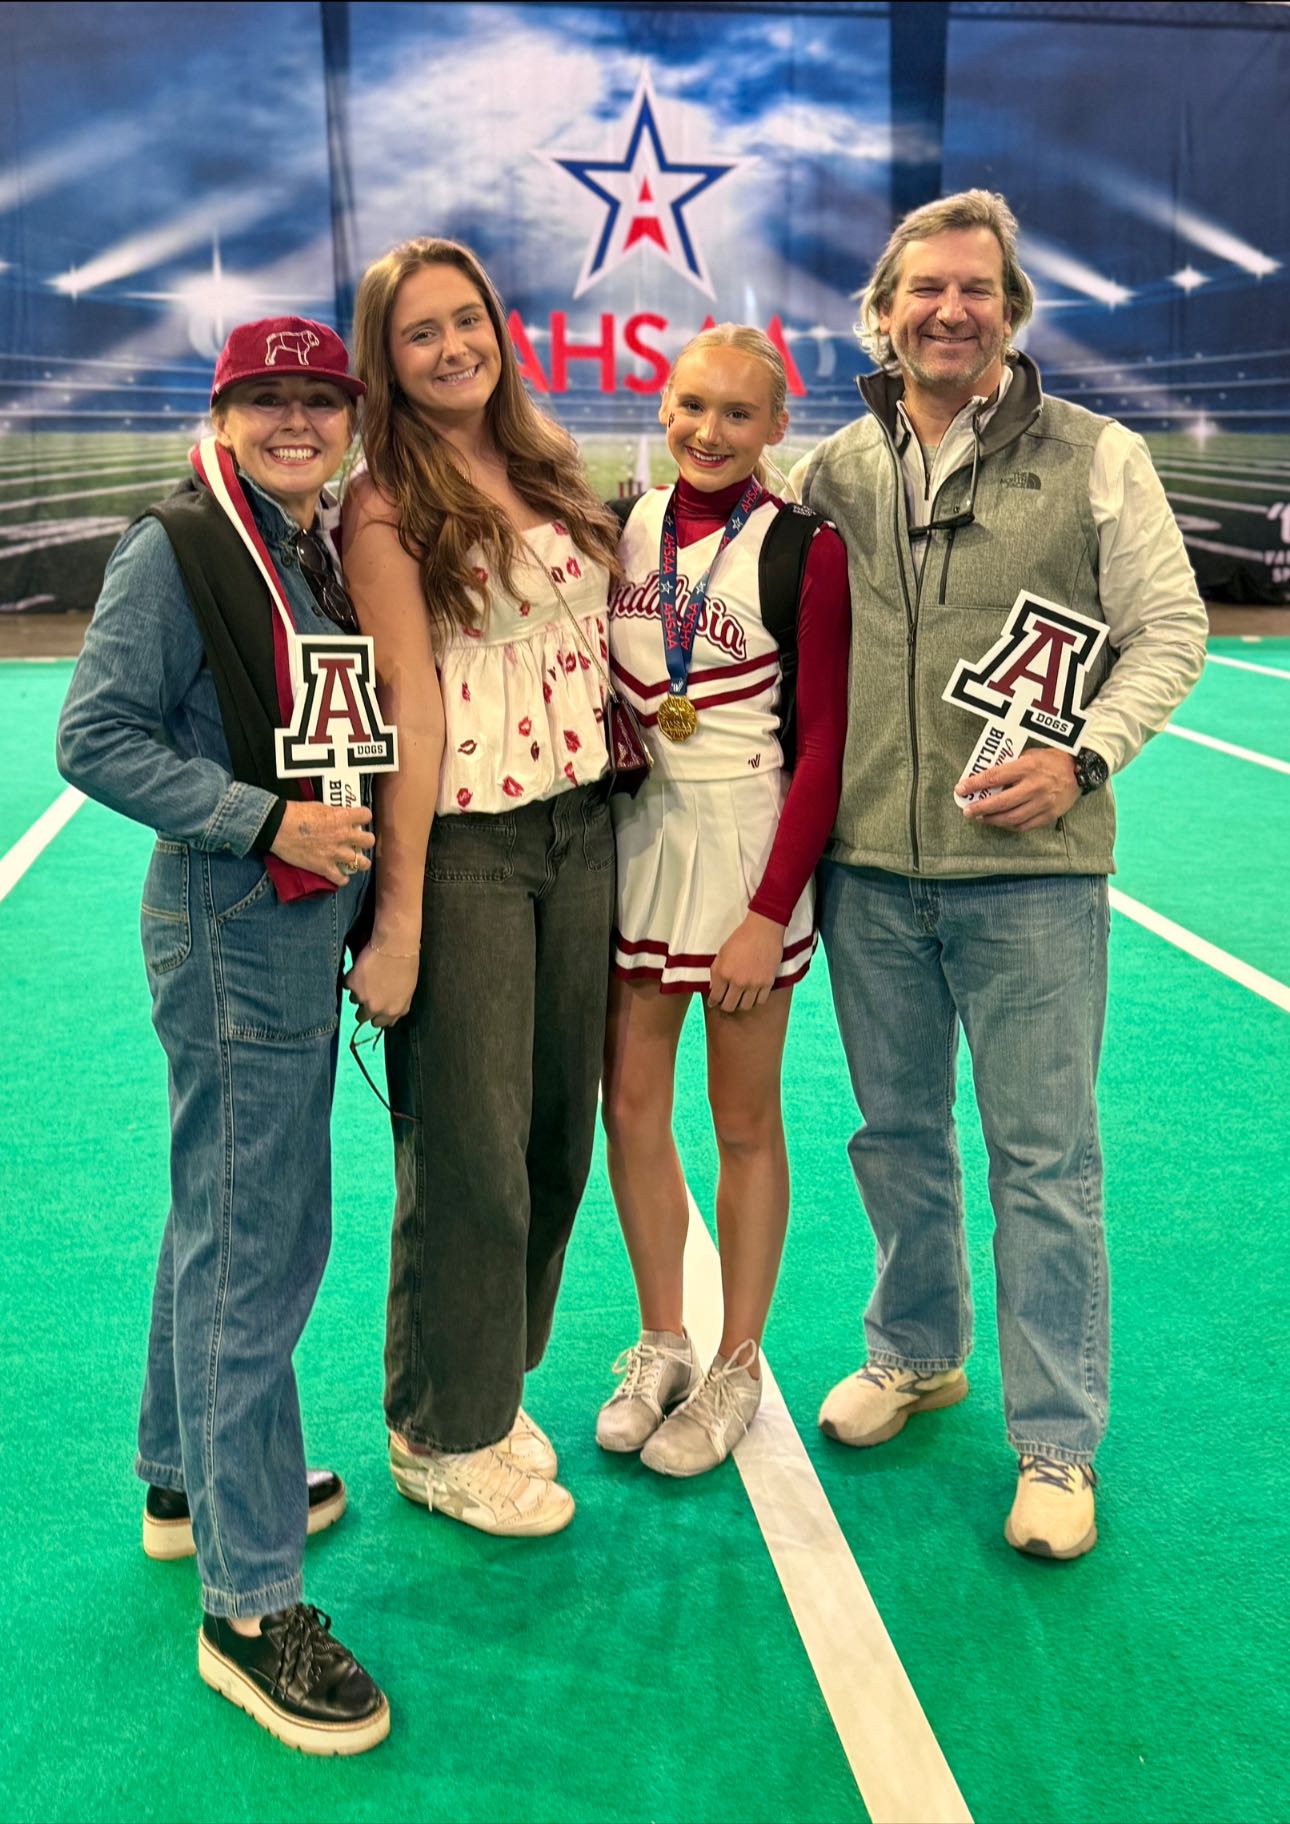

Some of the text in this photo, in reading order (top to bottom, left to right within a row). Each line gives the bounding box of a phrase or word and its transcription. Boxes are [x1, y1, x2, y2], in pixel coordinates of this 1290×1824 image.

[663, 531, 674, 575] AHSAA
[664, 602, 679, 651] AHSAA
[680, 602, 699, 651] AHSAA
[1034, 712, 1069, 733] DOGS
[357, 744, 384, 755] DOGS
